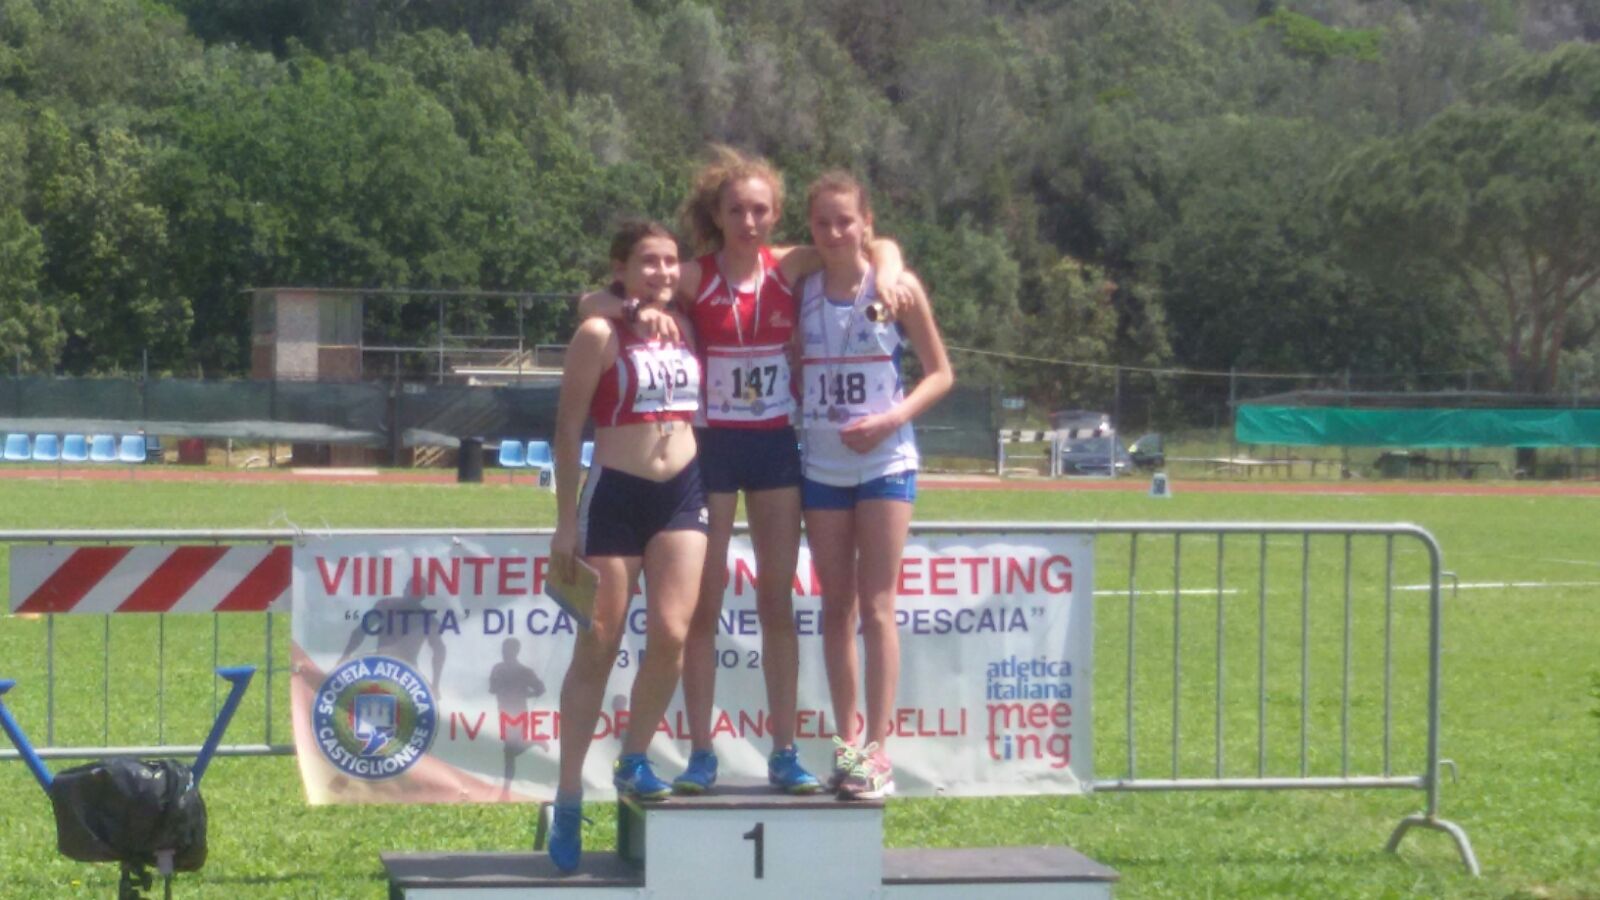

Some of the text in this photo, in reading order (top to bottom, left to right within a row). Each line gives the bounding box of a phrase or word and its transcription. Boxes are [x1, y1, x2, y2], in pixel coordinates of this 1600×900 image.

[732, 365, 778, 399] 147
[818, 372, 866, 405] 148
[315, 556, 393, 596] VIII
[896, 554, 1073, 596] EETING
[483, 608, 515, 635] DI
[986, 655, 1072, 678] atletica
[373, 661, 430, 715] ATLETICA
[986, 677, 1072, 700] italiana
[449, 707, 967, 740] IV MEORAL ANEL ELLI
[320, 726, 429, 776] CASTIGLIONESE
[743, 822, 764, 879] 1
